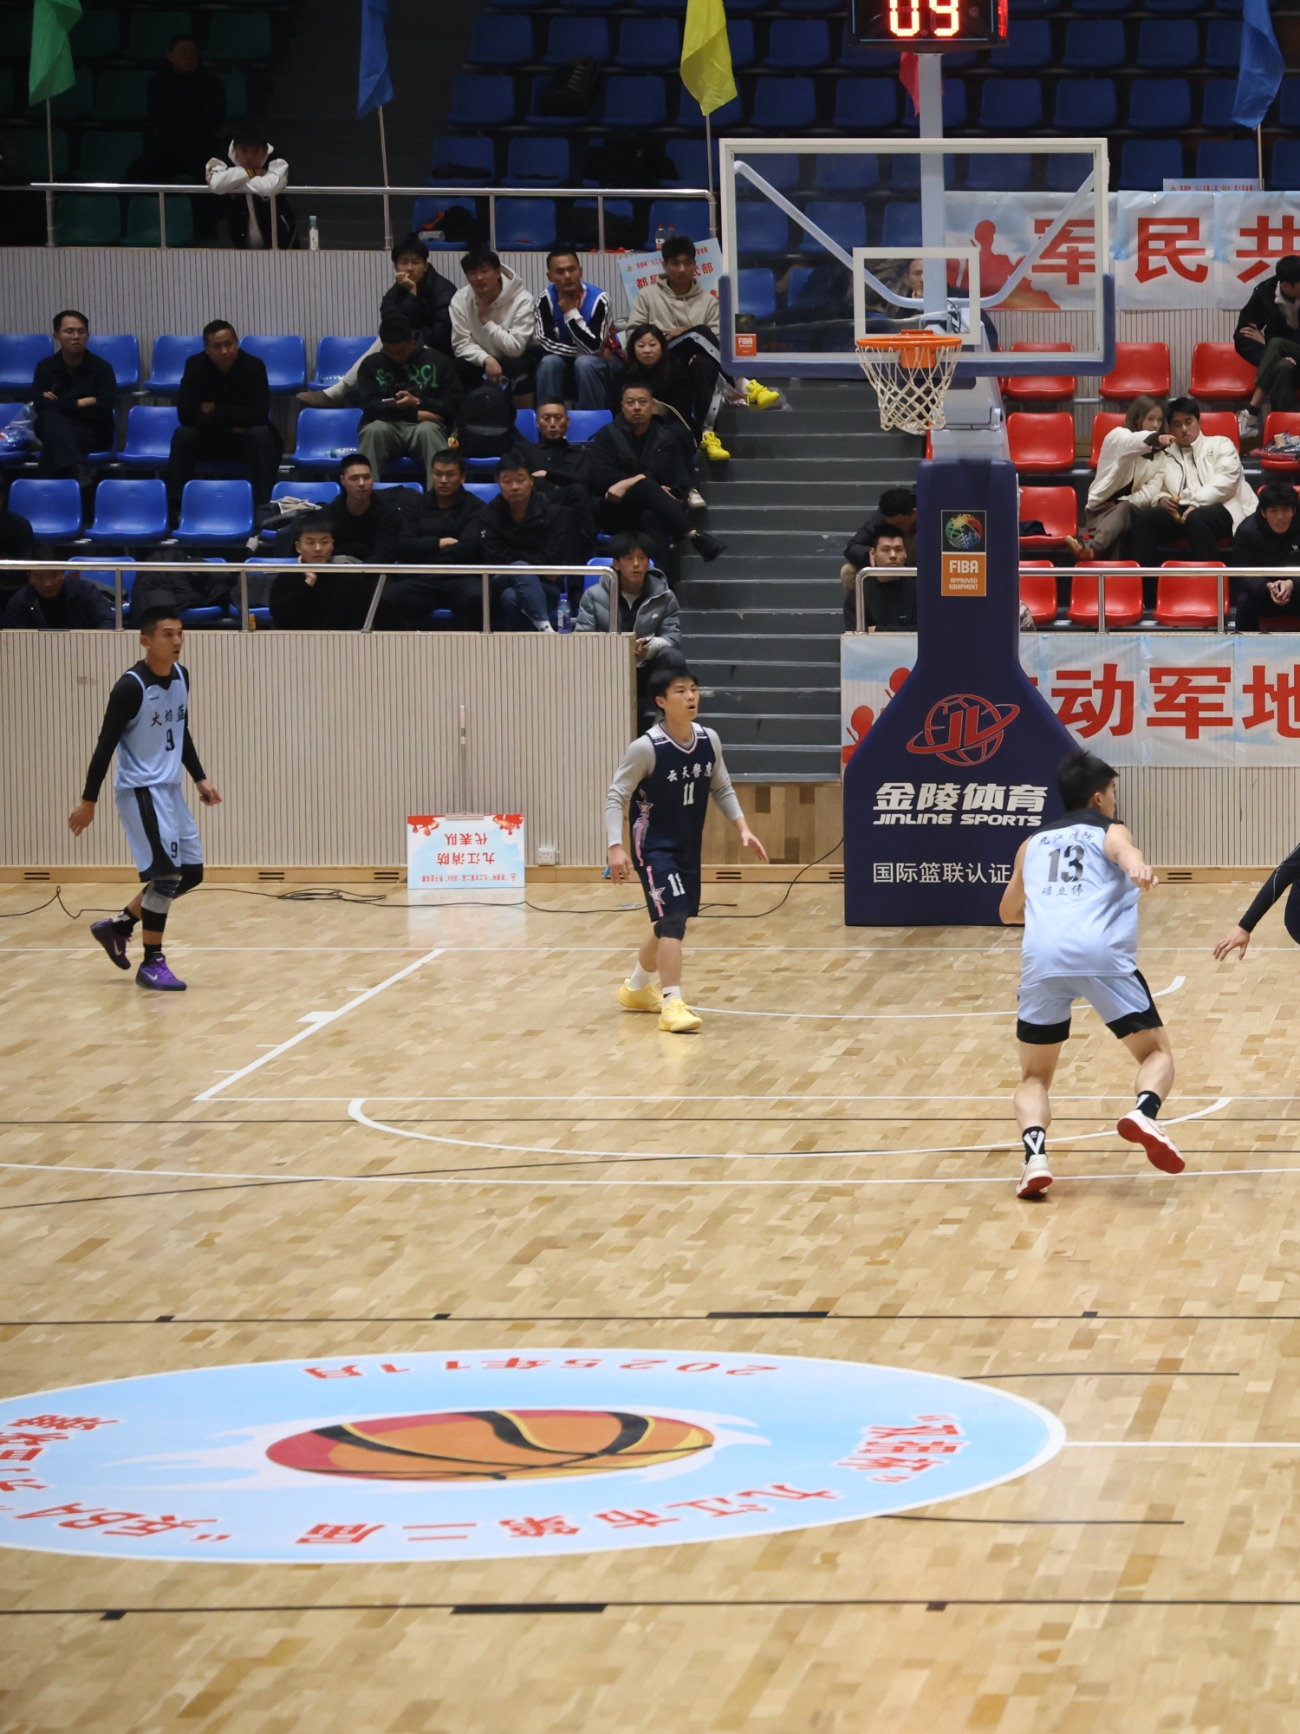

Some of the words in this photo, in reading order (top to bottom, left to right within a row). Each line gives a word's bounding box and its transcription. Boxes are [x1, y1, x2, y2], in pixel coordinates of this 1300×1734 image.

[889, 0, 960, 37] 09
[738, 337, 753, 345] FIBA
[949, 559, 979, 574] FIBA
[165, 728, 175, 752] 9
[682, 781, 695, 806] 11
[873, 782, 1048, 812] 金陵体育
[873, 813, 953, 825] JINLING
[960, 813, 1042, 827] SPORTS
[170, 841, 178, 859] 9
[444, 832, 488, 846] 代表队
[436, 852, 495, 866] 九江消防
[1048, 844, 1085, 883] 13
[873, 862, 1011, 883] 国际篮联认证
[667, 872, 686, 897] 11
[304, 1357, 779, 1380] 2025年11月
